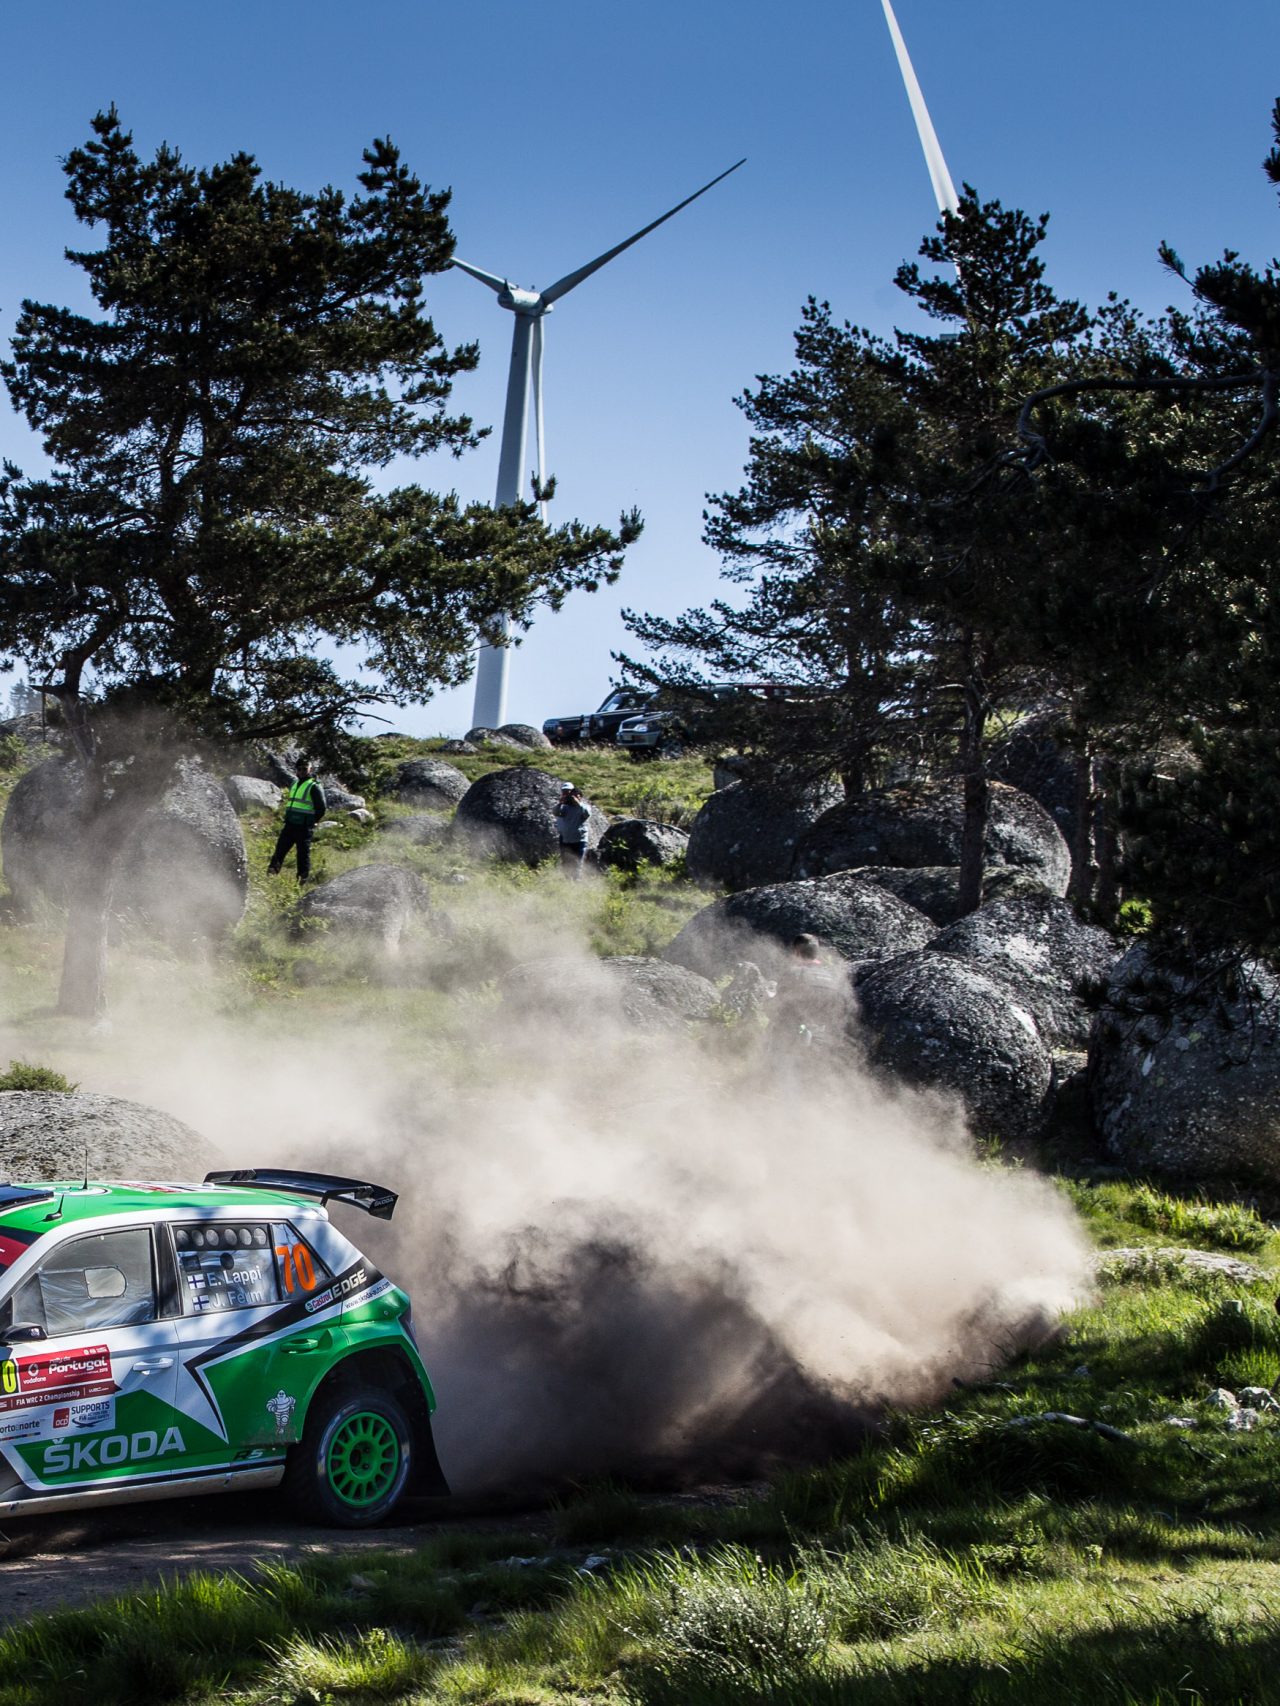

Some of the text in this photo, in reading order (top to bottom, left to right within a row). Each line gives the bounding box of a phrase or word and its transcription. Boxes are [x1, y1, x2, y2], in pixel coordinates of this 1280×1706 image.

[206, 1265, 262, 1287] E. Lappi
[275, 1242, 317, 1295] 70
[311, 1268, 368, 1309] Castrol EDGE
[212, 1293, 226, 1308] J.
[48, 1356, 108, 1375] Portugal
[23, 1376, 47, 1385] vodafone
[26, 1396, 38, 1404] WRC
[44, 1389, 80, 1401] Championship
[71, 1400, 110, 1415] SUPPORTS
[43, 1426, 187, 1474] ŠKODA
